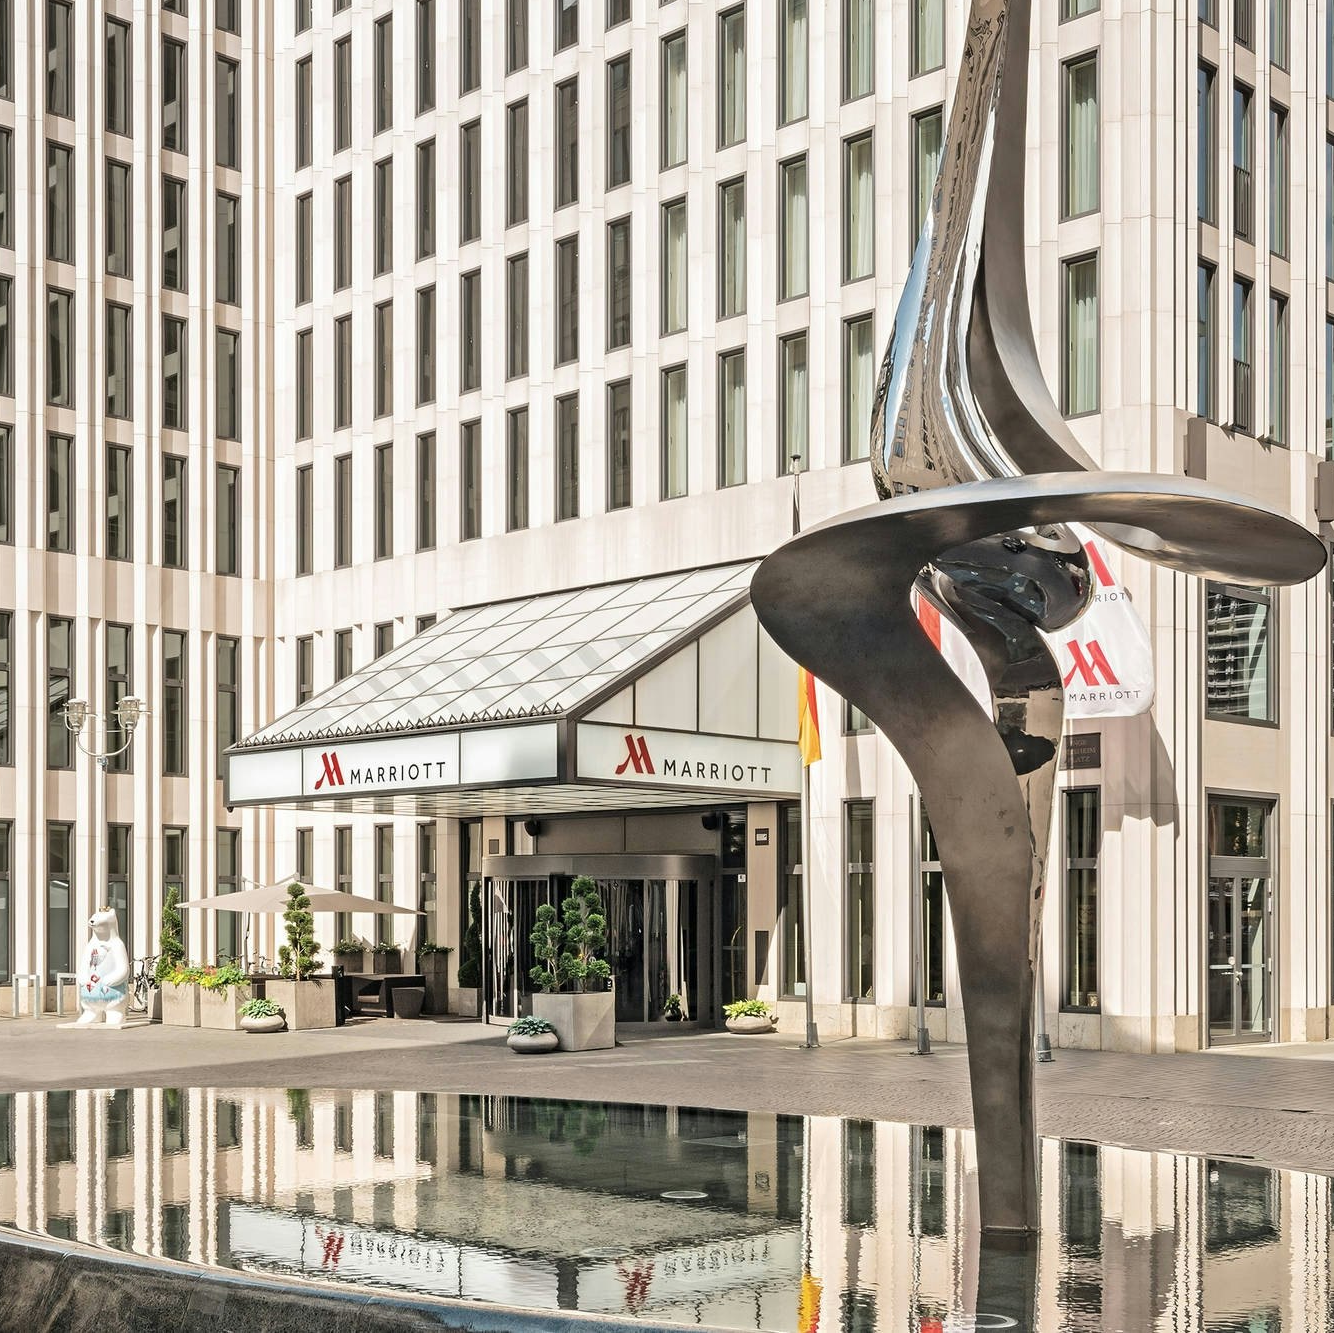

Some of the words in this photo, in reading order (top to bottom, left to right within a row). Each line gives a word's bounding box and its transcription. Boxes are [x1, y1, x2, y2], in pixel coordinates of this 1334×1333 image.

[1068, 690, 1141, 702] MARRIOTT
[350, 762, 446, 785] MARRIOTT
[663, 759, 772, 784] MARRIOTT
